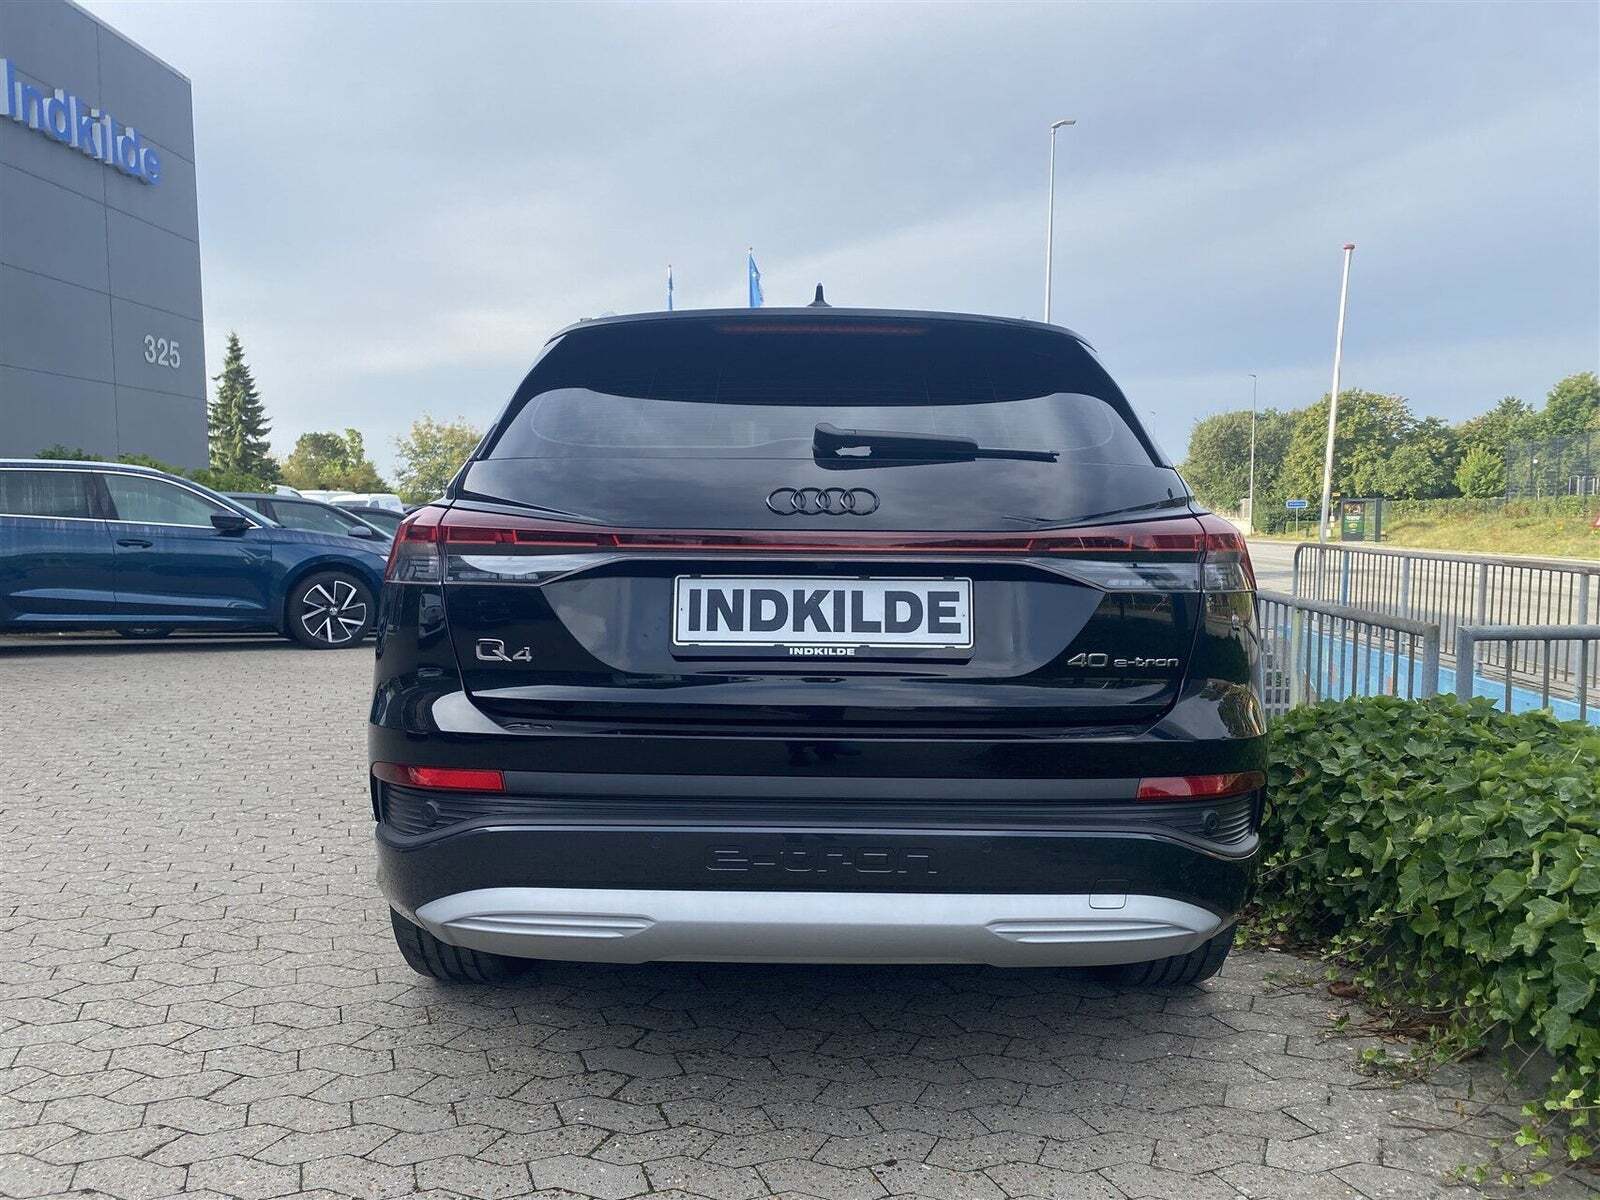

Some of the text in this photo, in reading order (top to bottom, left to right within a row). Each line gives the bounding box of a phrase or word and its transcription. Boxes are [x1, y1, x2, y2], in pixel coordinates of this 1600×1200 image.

[0, 57, 161, 186] Indkilde
[143, 334, 181, 369] 325
[688, 588, 962, 635] INDKILDE
[476, 638, 533, 662] Q4
[788, 647, 856, 657] INDKILDE
[1067, 652, 1179, 668] 40 e-tron
[705, 845, 938, 875] e-tron
